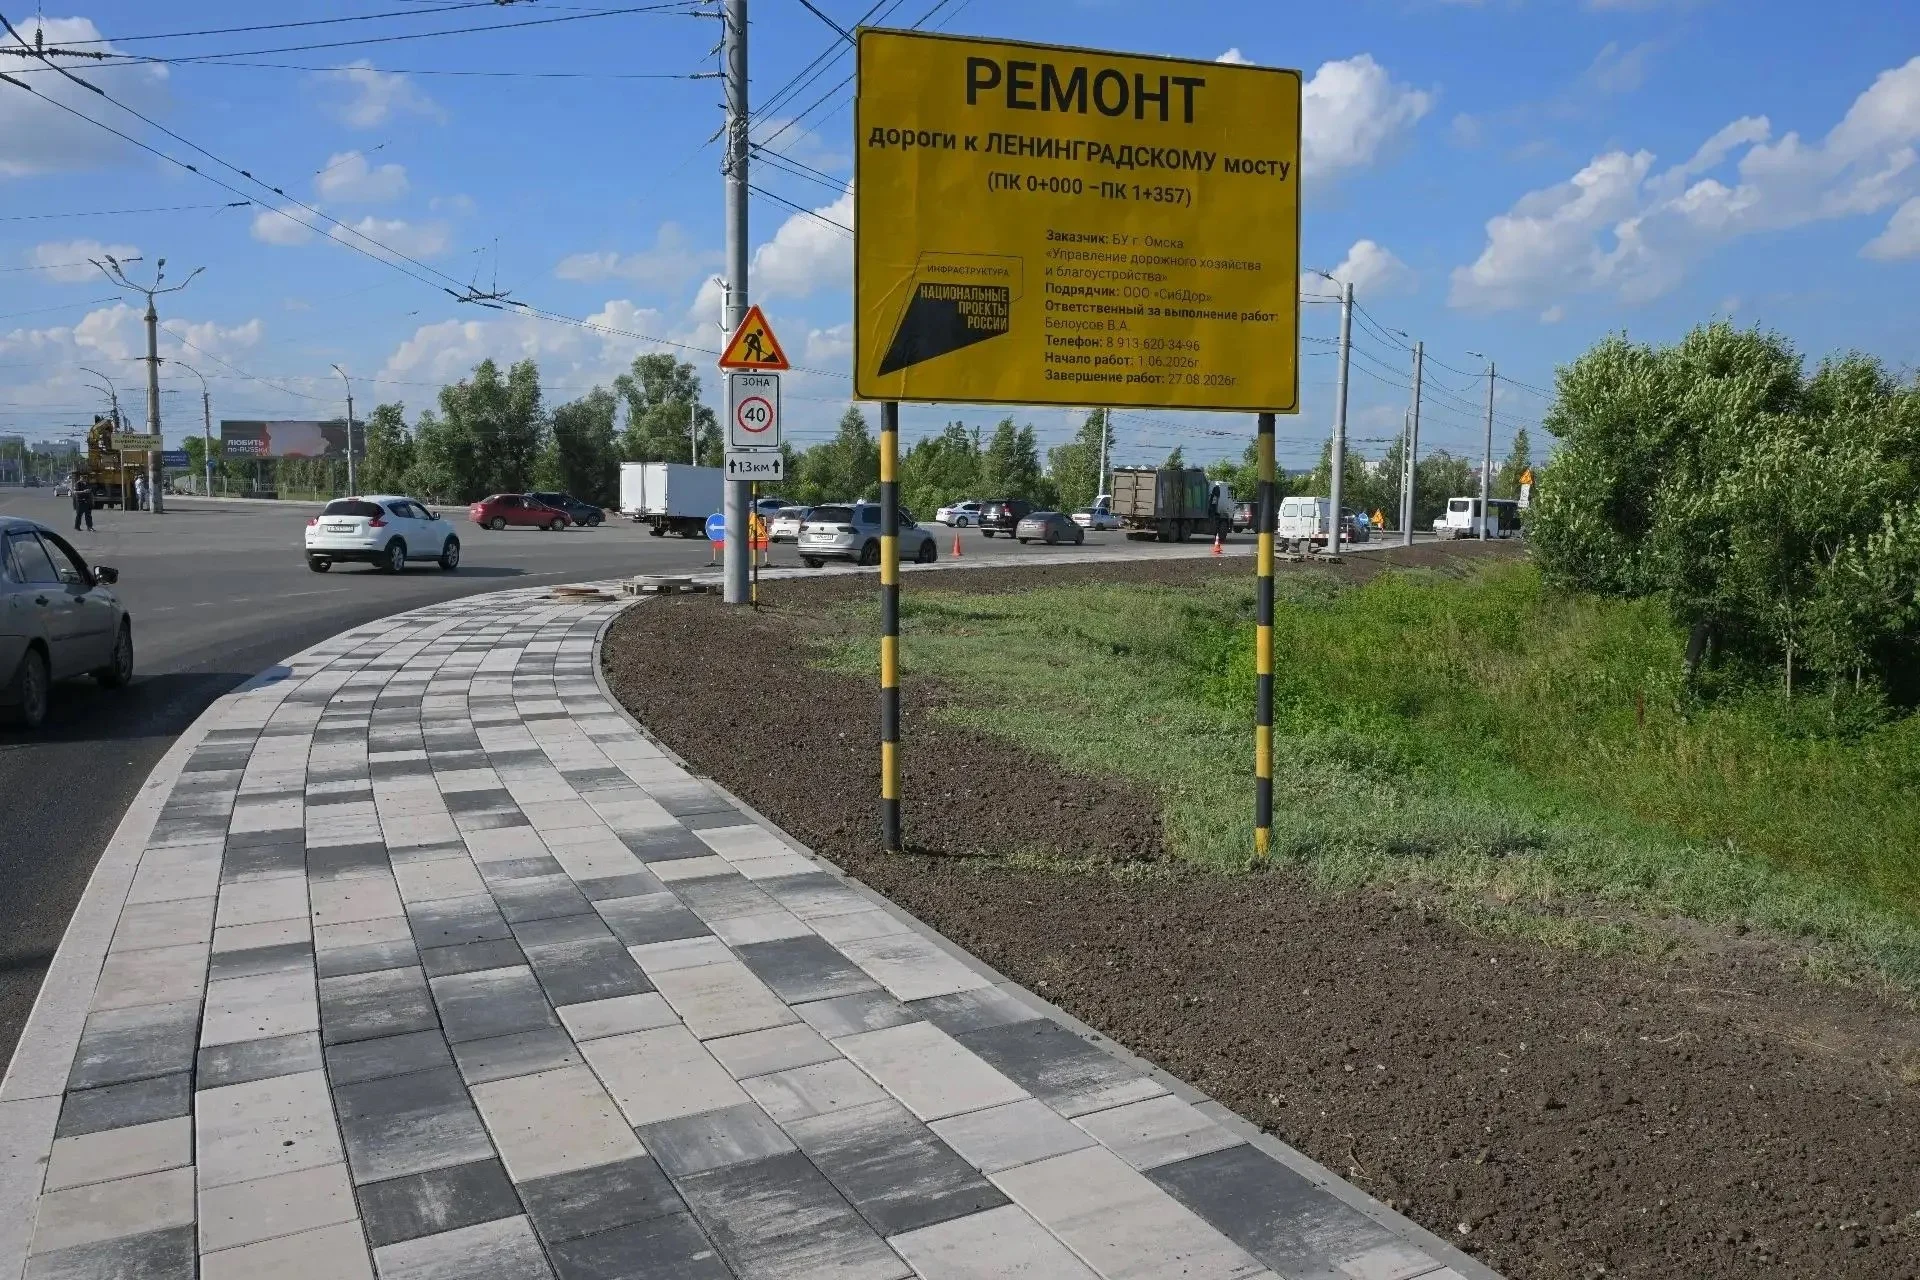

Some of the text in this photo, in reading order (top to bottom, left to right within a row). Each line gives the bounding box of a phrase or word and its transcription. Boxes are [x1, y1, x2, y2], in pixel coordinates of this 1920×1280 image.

[966, 56, 1206, 123] РЕМОНТ
[868, 127, 1291, 182] дороги к ЛЕНИНГРАДСКОМУ мосту
[987, 171, 1022, 193] (ПК
[1026, 175, 1083, 195] 0+000
[1132, 184, 1192, 209] 1+357)
[1046, 229, 1109, 245] Заказчик:
[1112, 233, 1129, 245] БУ
[1144, 235, 1184, 249] Омска
[1046, 247, 1262, 271] «Управление дорожного хозяйства
[927, 264, 1010, 277] ИНФРАСТРУКТУРА
[1045, 264, 1168, 282] и благоустройства»
[920, 285, 1008, 302] НАЦИОНАЛЬНЫЕ
[1045, 282, 1120, 299] Подрядчик:
[1123, 286, 1150, 298] ООО
[958, 301, 1008, 316] ПРОЕКТЫ
[1045, 299, 1279, 323] Ответственный за выполнение работ:
[967, 315, 1008, 331] РОССИИ
[1045, 317, 1104, 331] Белоусов
[1045, 334, 1103, 349] Телефон:
[1106, 336, 1114, 348] 8
[1045, 351, 1091, 364] Начало
[1094, 354, 1134, 368] работ:
[742, 377, 770, 387] ЗОНА
[1045, 368, 1123, 384] Завершение
[1126, 372, 1165, 385] работ:
[744, 407, 766, 423] 40
